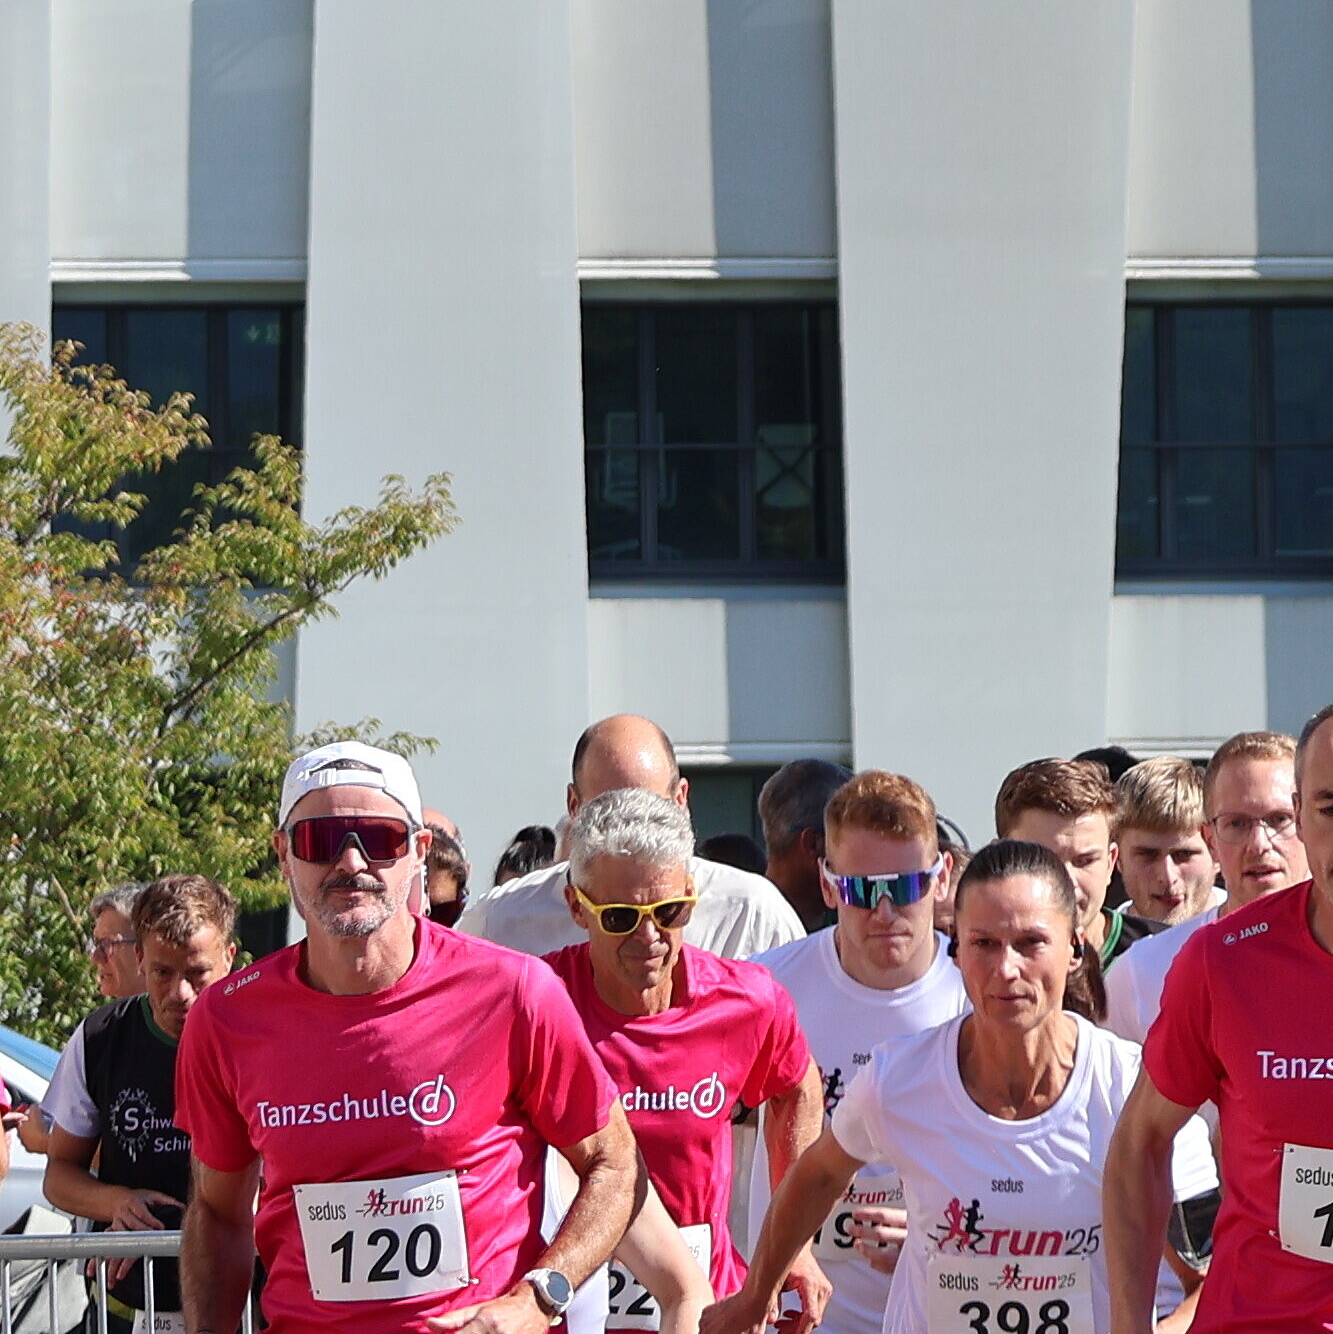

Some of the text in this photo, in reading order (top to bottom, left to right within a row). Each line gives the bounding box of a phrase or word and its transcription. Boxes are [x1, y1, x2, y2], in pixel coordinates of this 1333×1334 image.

[1239, 922, 1269, 940] JAKO
[236, 970, 260, 989] JAKO
[124, 1107, 174, 1132] Schw
[991, 1177, 1024, 1194] sedus
[308, 1200, 347, 1221] sedus
[331, 1222, 442, 1283] 120
[939, 1271, 979, 1292] sedus
